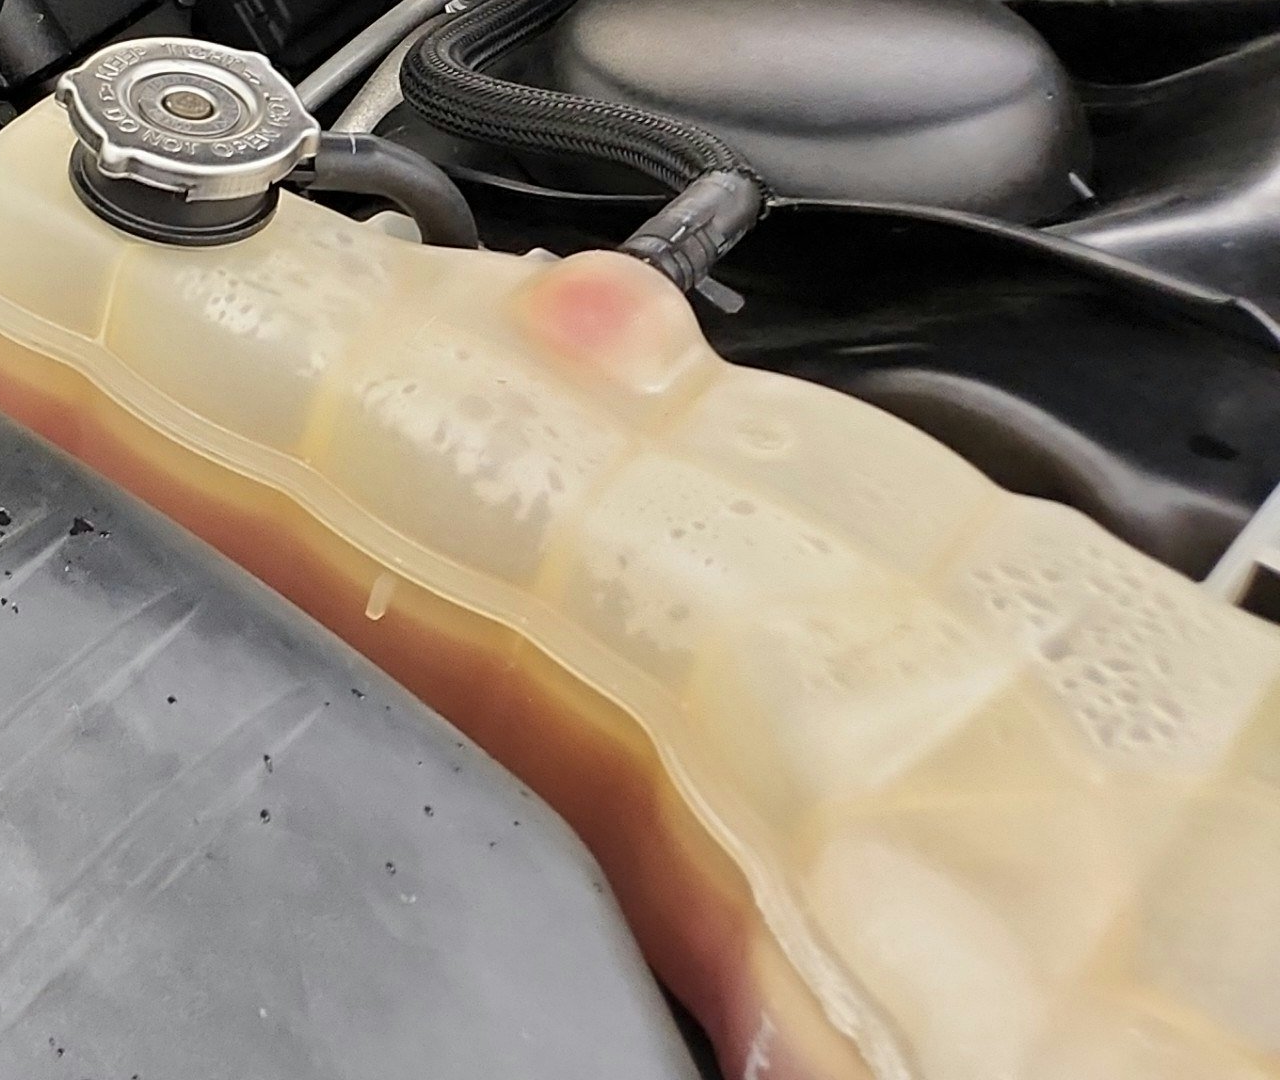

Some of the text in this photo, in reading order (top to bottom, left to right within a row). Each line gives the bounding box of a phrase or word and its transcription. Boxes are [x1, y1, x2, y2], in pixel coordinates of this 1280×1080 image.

[96, 42, 246, 81] KEEP TIGHT
[103, 107, 141, 133] DO
[143, 129, 199, 156] NOT
[212, 128, 282, 158] OPEN
